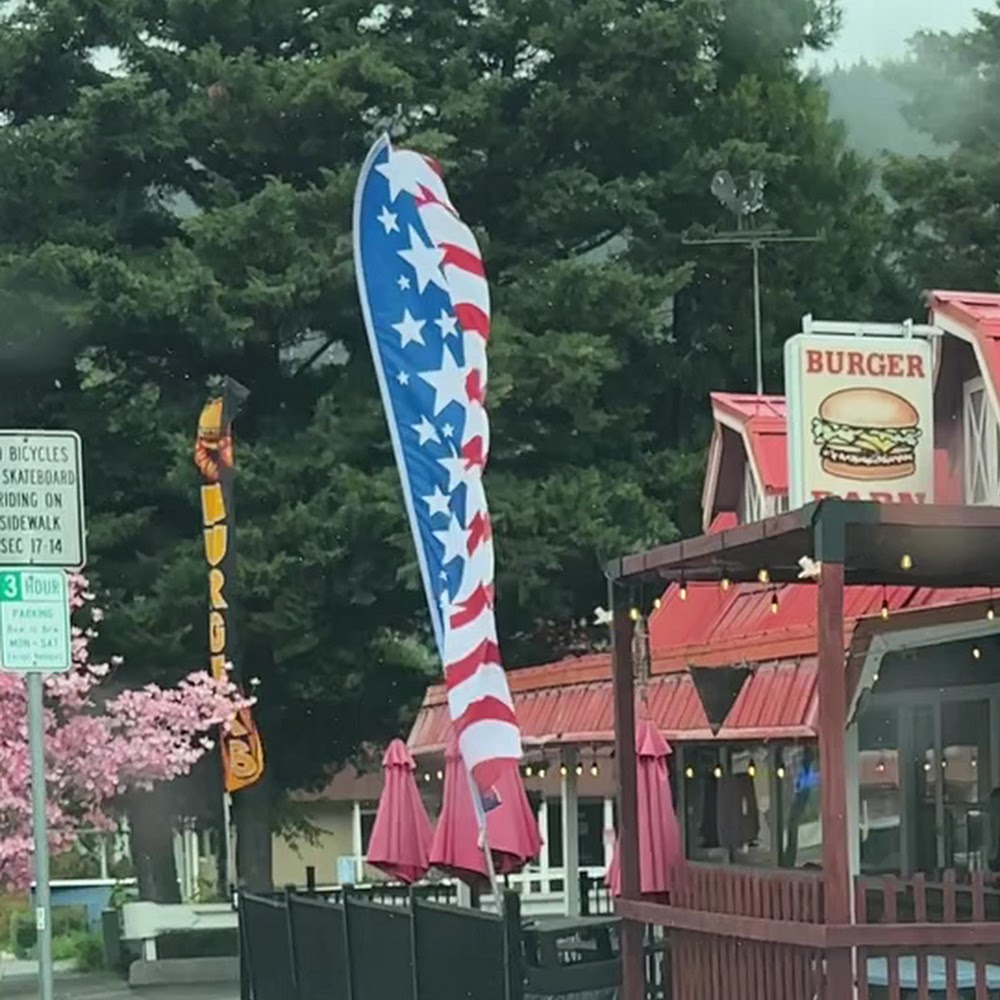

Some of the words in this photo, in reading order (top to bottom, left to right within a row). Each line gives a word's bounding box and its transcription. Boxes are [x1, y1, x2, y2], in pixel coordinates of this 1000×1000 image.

[806, 350, 925, 378] BURGER
[9, 446, 69, 462] BICYCLES
[2, 468, 75, 485] SKATEBOARD
[45, 492, 62, 508] ON
[0, 514, 61, 531] SIDEWALK
[0, 537, 23, 554] SEC
[4, 574, 18, 598] 3
[25, 578, 60, 595] HOUR
